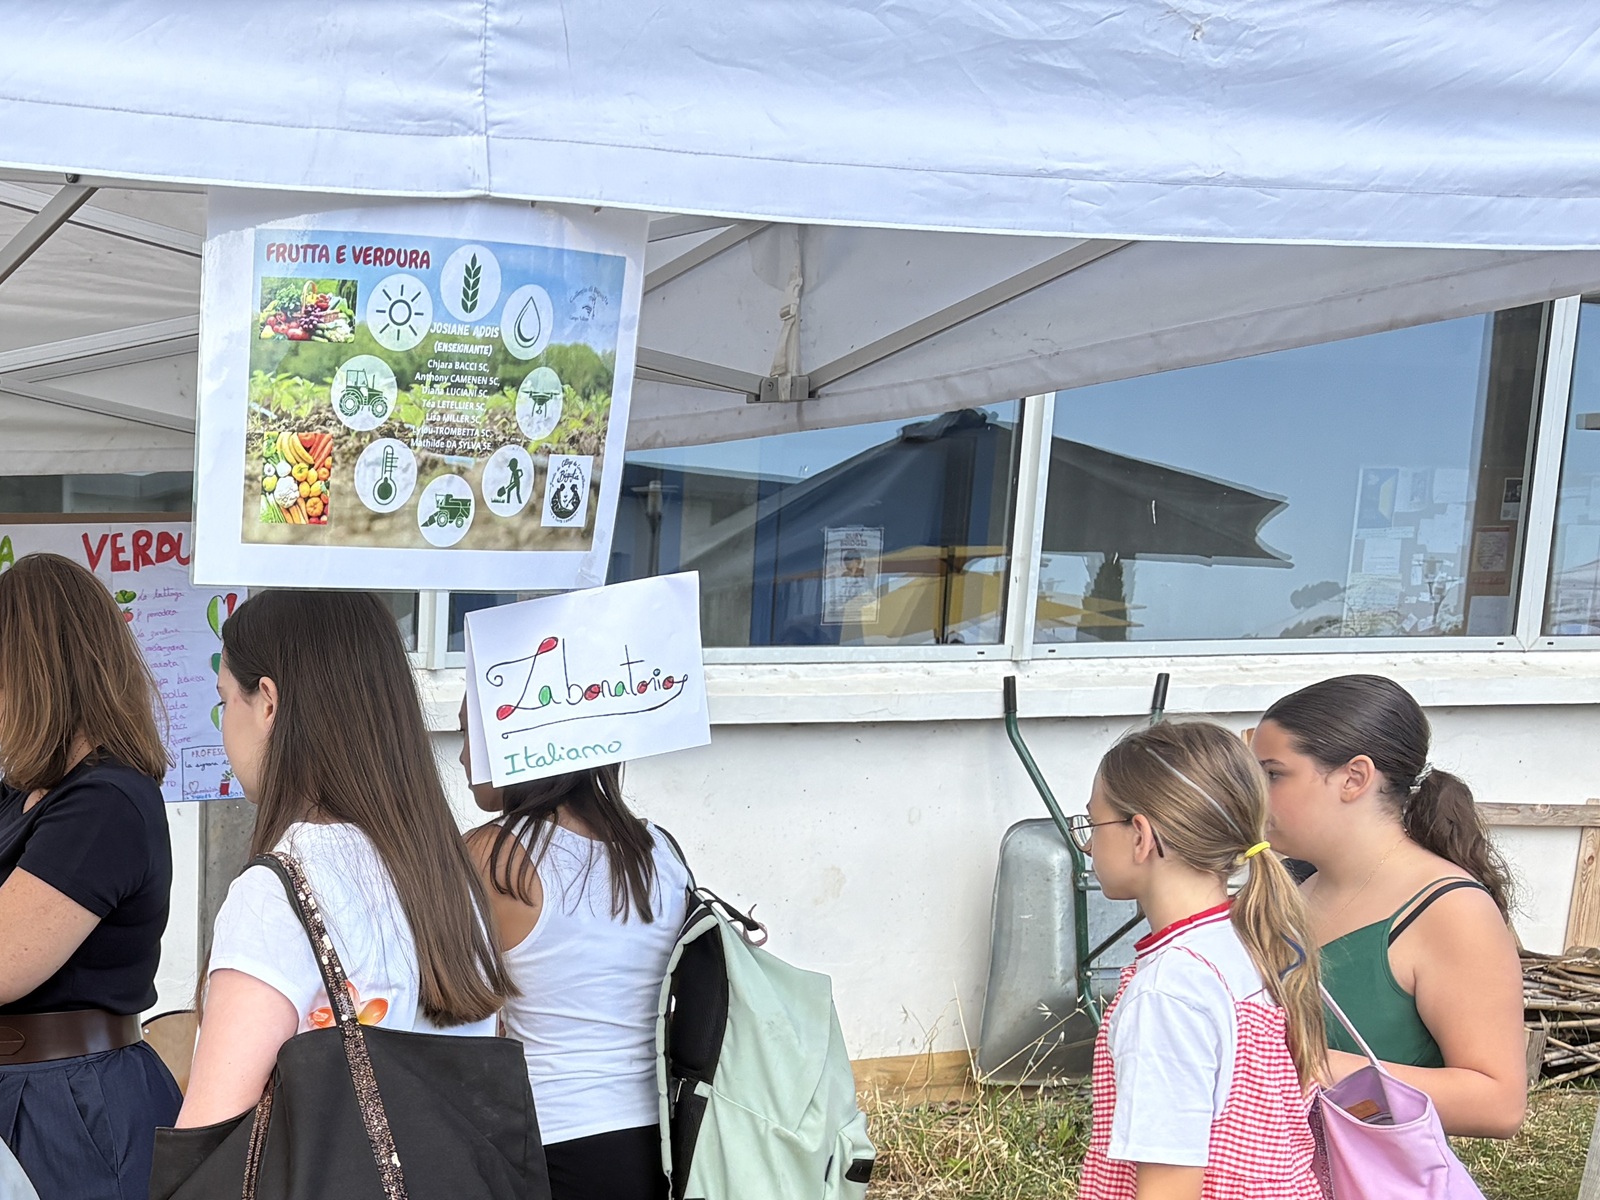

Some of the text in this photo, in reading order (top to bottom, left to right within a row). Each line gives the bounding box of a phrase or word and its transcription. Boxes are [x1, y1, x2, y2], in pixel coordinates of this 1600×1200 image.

[266, 242, 430, 270] FRUTTA E VERDURA
[430, 322, 500, 338] JOSIANE ADDIS
[434, 340, 493, 357] (ENSEIGNANTE)
[427, 359, 453, 371] Chjara
[455, 361, 477, 371] BACCI
[414, 371, 449, 383] Anthony
[450, 374, 488, 385] CAMENEN
[446, 388, 477, 397] LUCIANI
[437, 400, 474, 410] LETELLIER
[426, 413, 441, 422] Lisa
[443, 414, 470, 423] MILLER
[446, 440, 457, 448] DA
[458, 441, 481, 450] SYLVA
[486, 636, 688, 721] Laboratorio
[162, 689, 188, 699] polla
